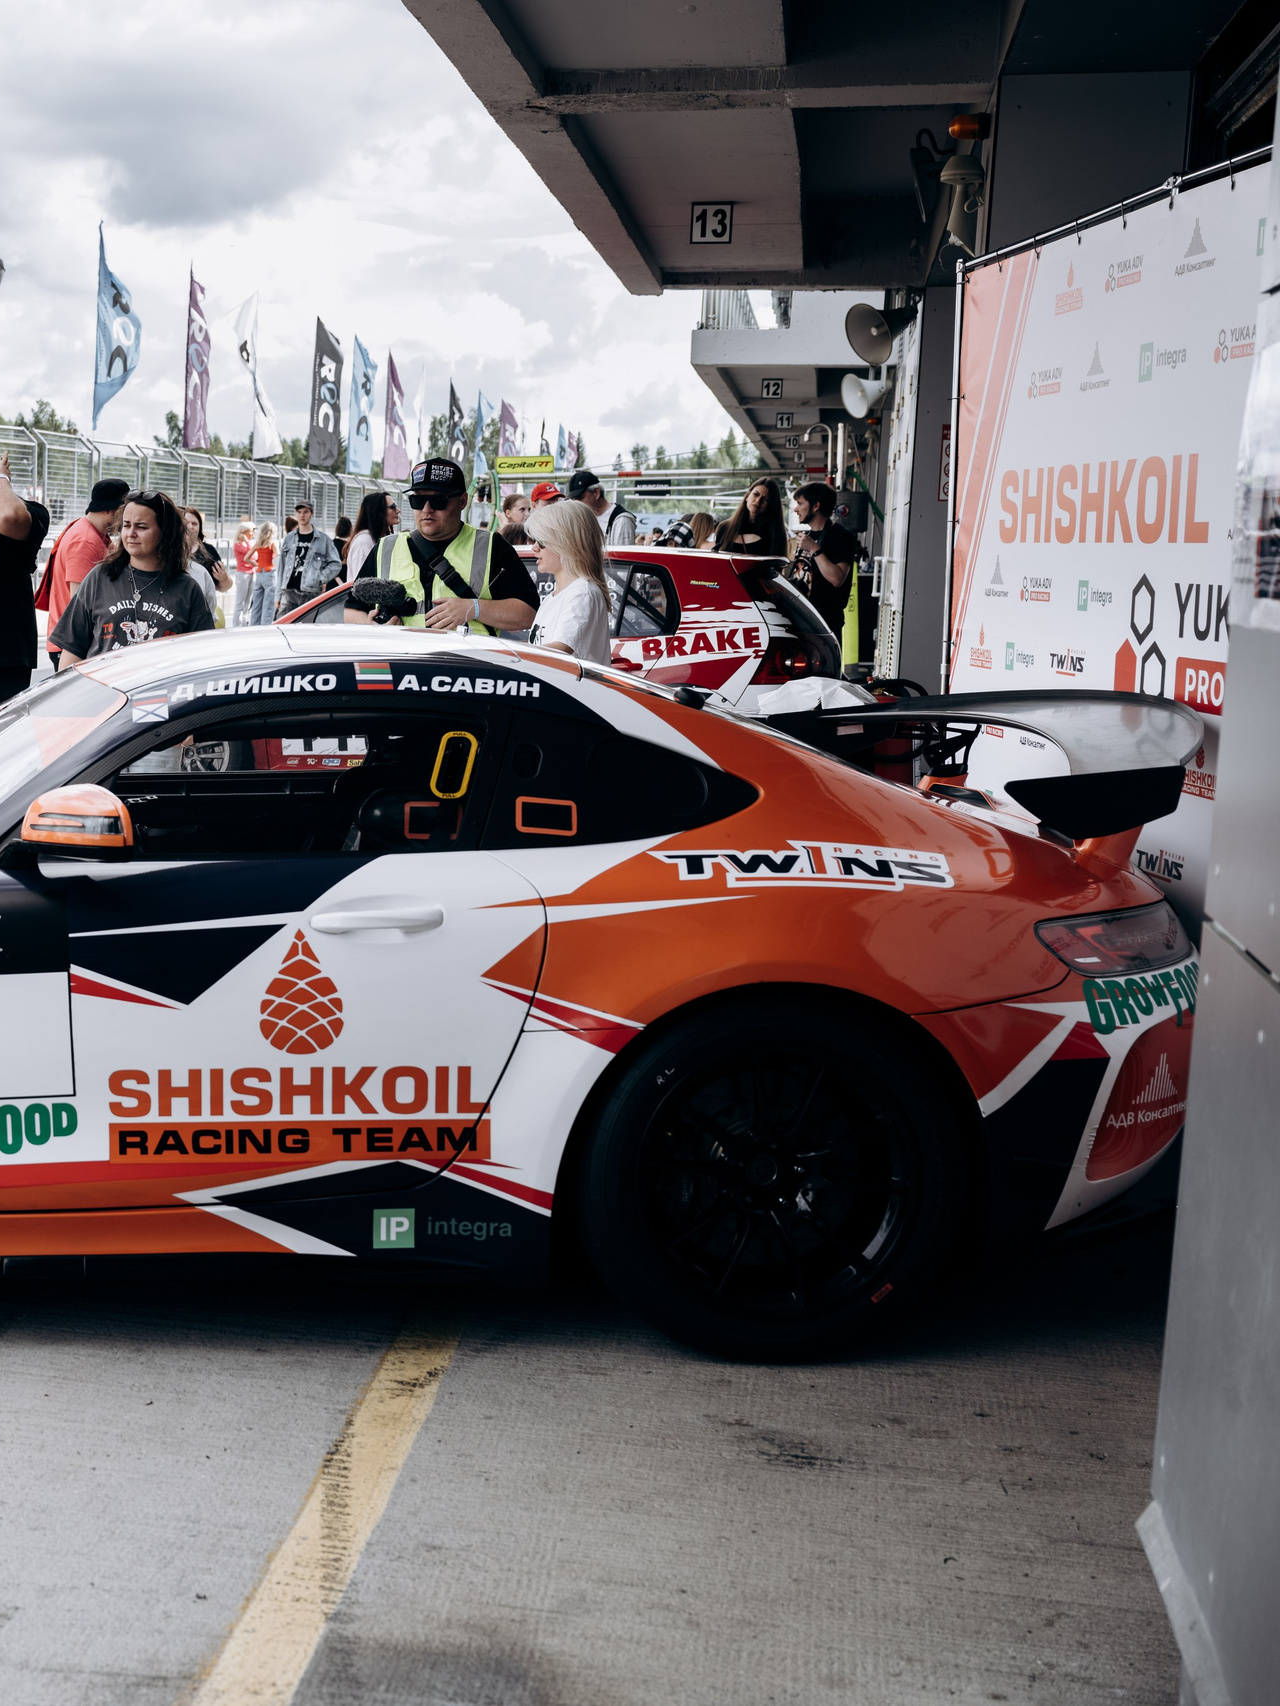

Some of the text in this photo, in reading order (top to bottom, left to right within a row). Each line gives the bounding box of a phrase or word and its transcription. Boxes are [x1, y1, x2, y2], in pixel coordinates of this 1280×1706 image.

[695, 208, 728, 238] 13
[1174, 257, 1216, 277] АДВ Консалтинг
[1230, 325, 1250, 342] YUKA
[1156, 347, 1187, 370] integra
[763, 381, 781, 397] 12
[779, 415, 791, 427] 11
[786, 437, 798, 448] 10
[999, 453, 1209, 544] SHISHKOIL
[1091, 588, 1113, 607] integra
[109, 600, 174, 621] DAILY DISHES
[1174, 582, 1229, 643] YUK
[103, 622, 114, 633] TO
[642, 626, 762, 662] BRAKE
[970, 647, 993, 661] SHISHKOIL
[1016, 650, 1035, 668] integra
[171, 673, 338, 702] Д.ШИШКО
[397, 675, 541, 698] А.САВИН
[1184, 667, 1225, 707] PRO
[663, 845, 949, 884] TWINS
[833, 846, 939, 862] RACING
[1136, 849, 1184, 881] TWINS
[1165, 850, 1185, 862] RACING
[108, 1065, 491, 1118] SHISHKOIL
[1106, 1101, 1187, 1130] АДВ Консалтин
[118, 1126, 478, 1156] RACING TEAM
[379, 1216, 513, 1242] IP integra
